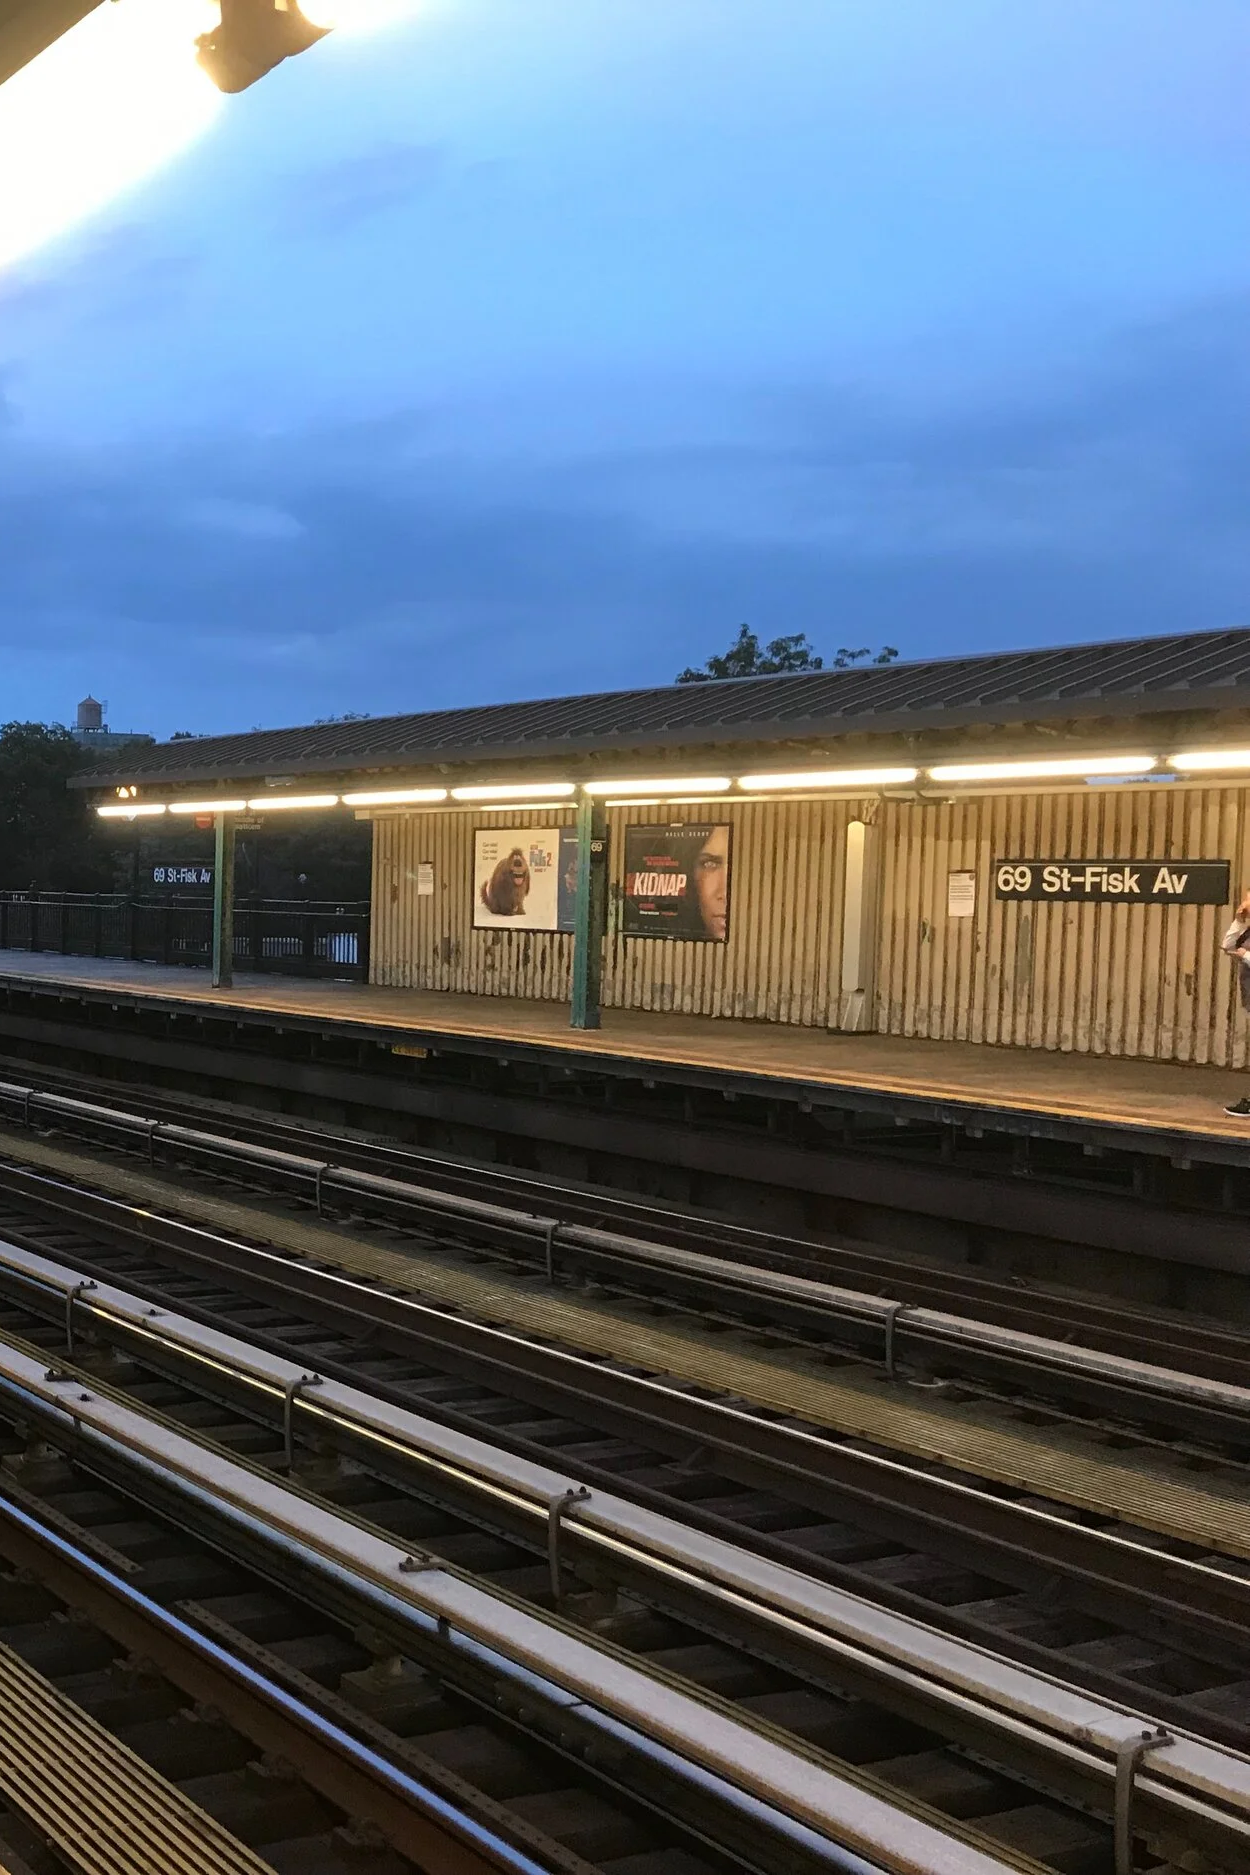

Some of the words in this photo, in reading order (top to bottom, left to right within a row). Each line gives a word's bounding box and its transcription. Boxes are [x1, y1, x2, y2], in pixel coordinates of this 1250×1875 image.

[590, 842, 603, 852] 69
[153, 868, 165, 883] 69
[167, 868, 198, 883] St-Fisk
[200, 868, 211, 884] Av
[633, 872, 687, 896] KIDNAP
[997, 866, 1032, 892] 69
[1042, 866, 1141, 893] St-Fisk
[1151, 867, 1188, 894] Av
